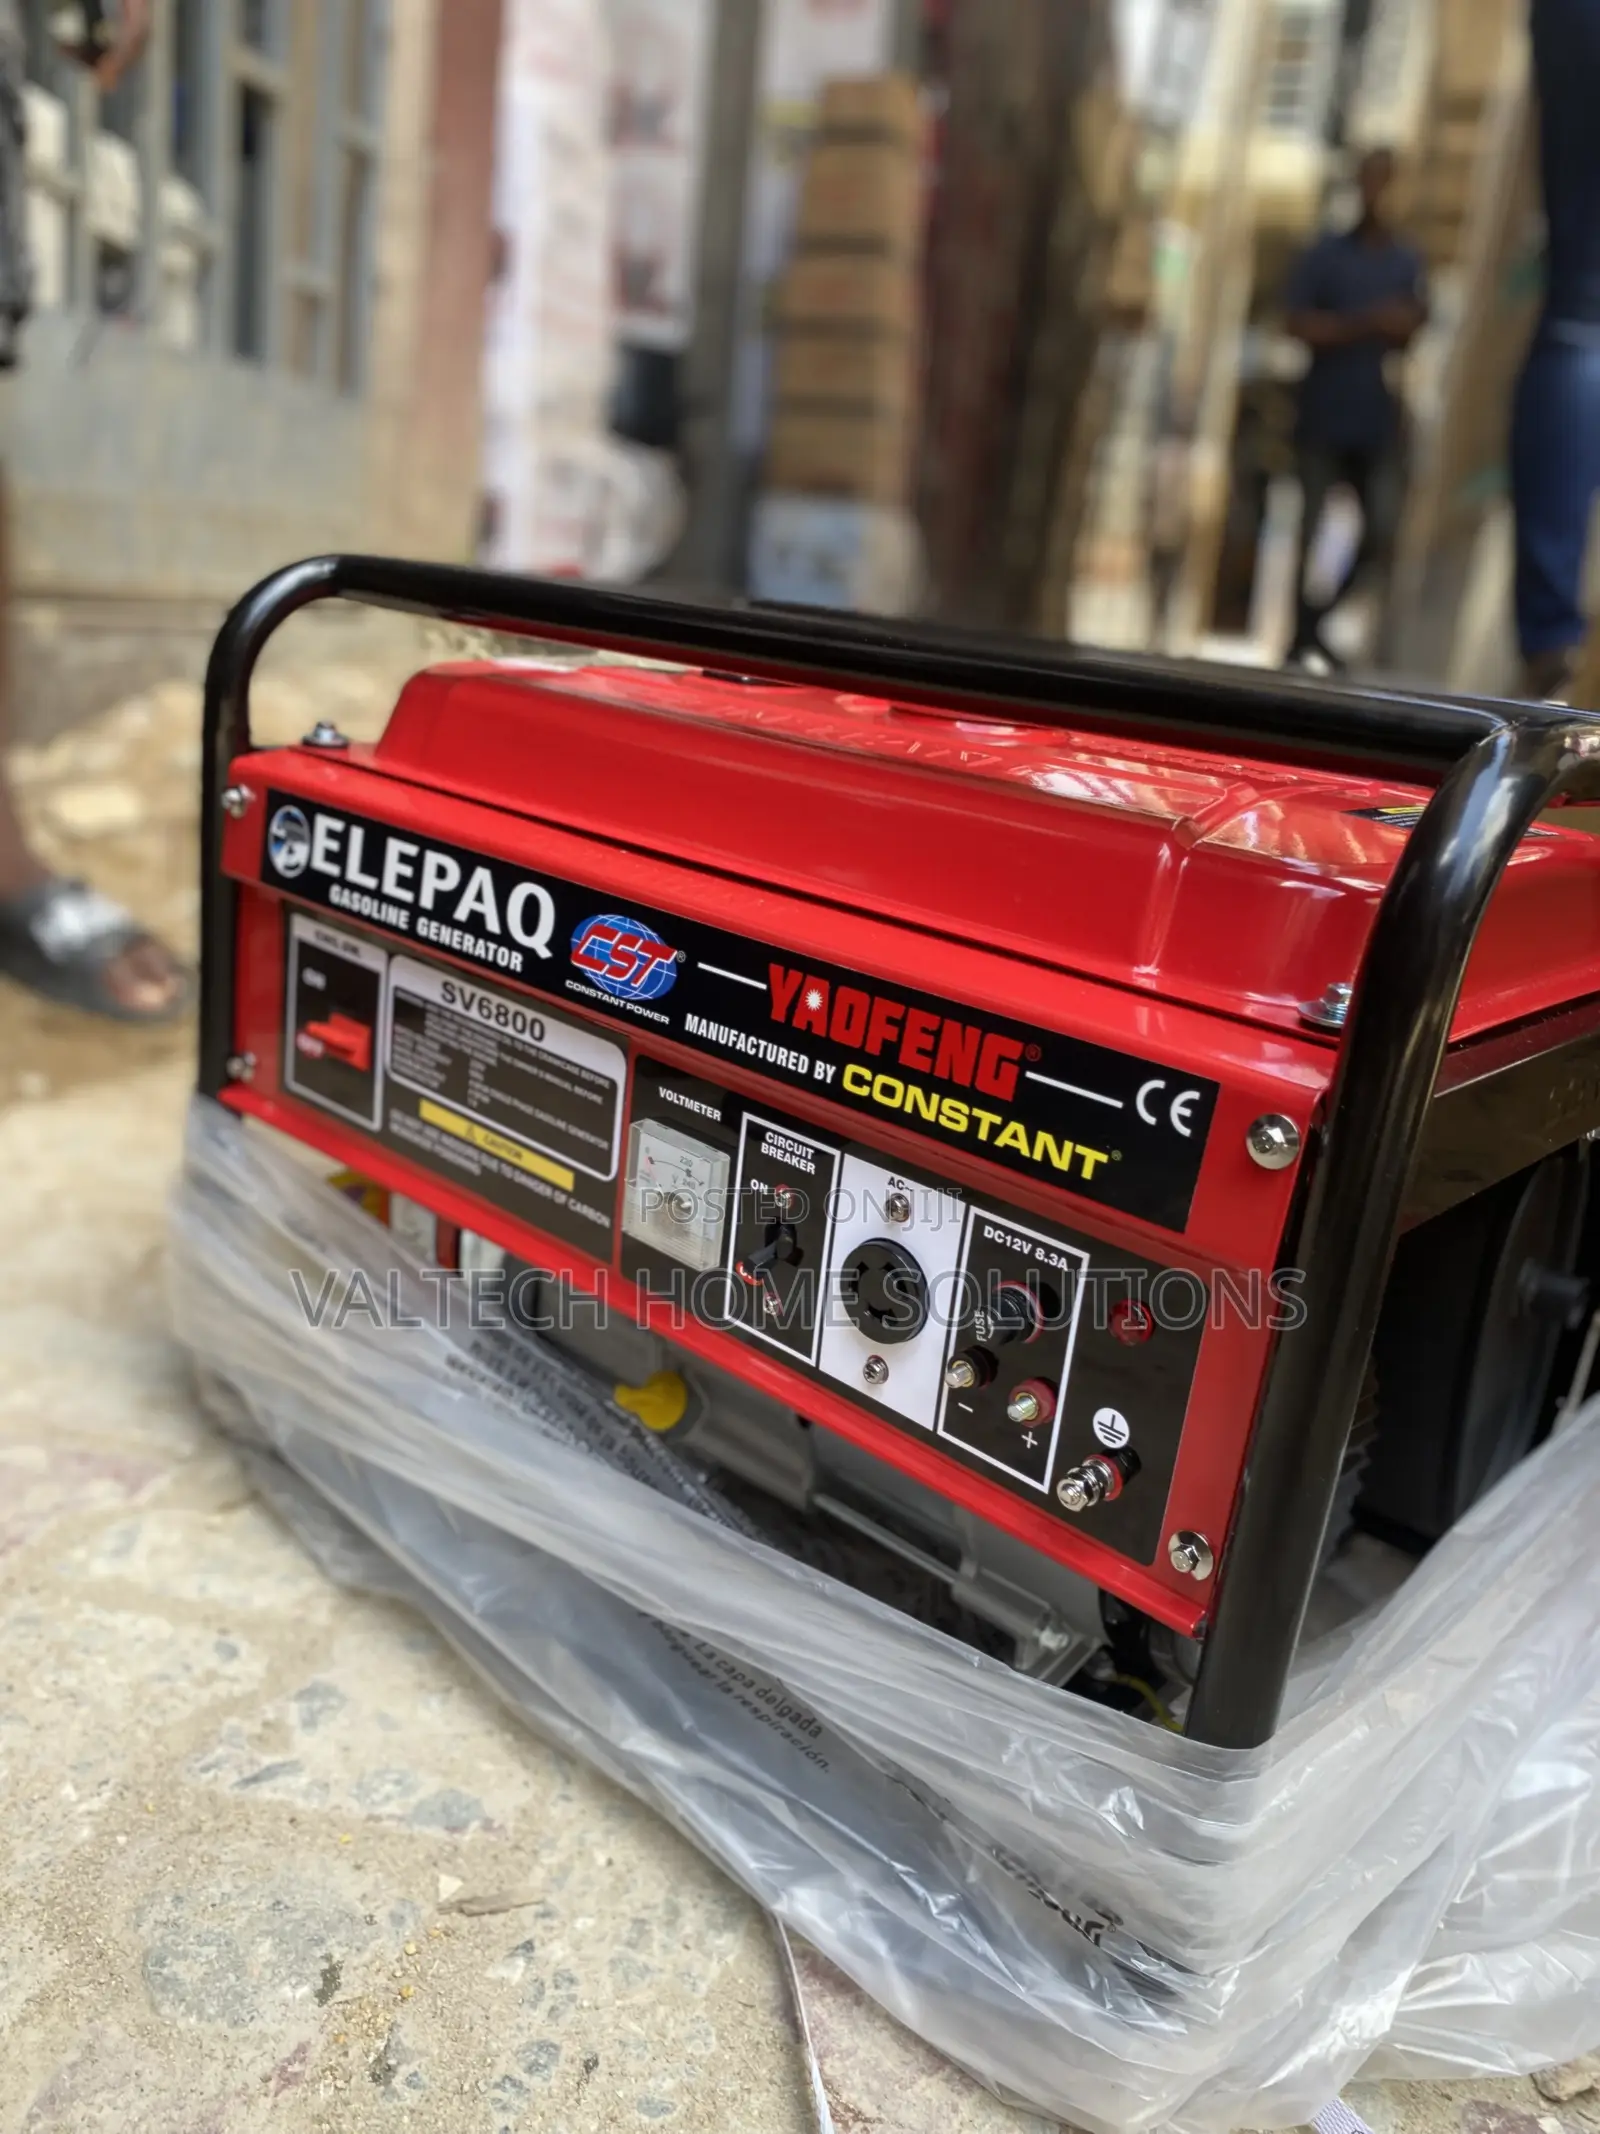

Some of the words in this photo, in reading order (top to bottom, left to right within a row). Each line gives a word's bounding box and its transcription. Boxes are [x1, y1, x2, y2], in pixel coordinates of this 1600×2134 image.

[310, 812, 556, 960] ELEPAQ
[328, 883, 410, 931] GASOLINE
[416, 916, 524, 973] GENERATOR
[570, 923, 678, 988] CST
[440, 980, 546, 1043] SV6800
[565, 979, 626, 1010] CONSTANT
[626, 1002, 670, 1026] POWER
[768, 963, 1026, 1102] YAOFENG
[658, 1086, 722, 1122] VOLTMETER
[684, 1013, 810, 1075] MANUFACTURED
[813, 1060, 837, 1085] BY
[842, 1063, 1109, 1181] CONSTANT
[761, 1142, 816, 1176] BREAKER
[765, 1131, 815, 1161] CIRCUIT
[750, 1178, 769, 1196] ON
[983, 1225, 1032, 1255] DC12V
[1034, 1247, 1069, 1272] 8.3A
[974, 1310, 988, 1343] FUSE
[715, 1659, 756, 1690] capa
[755, 1686, 824, 1740] delgada
